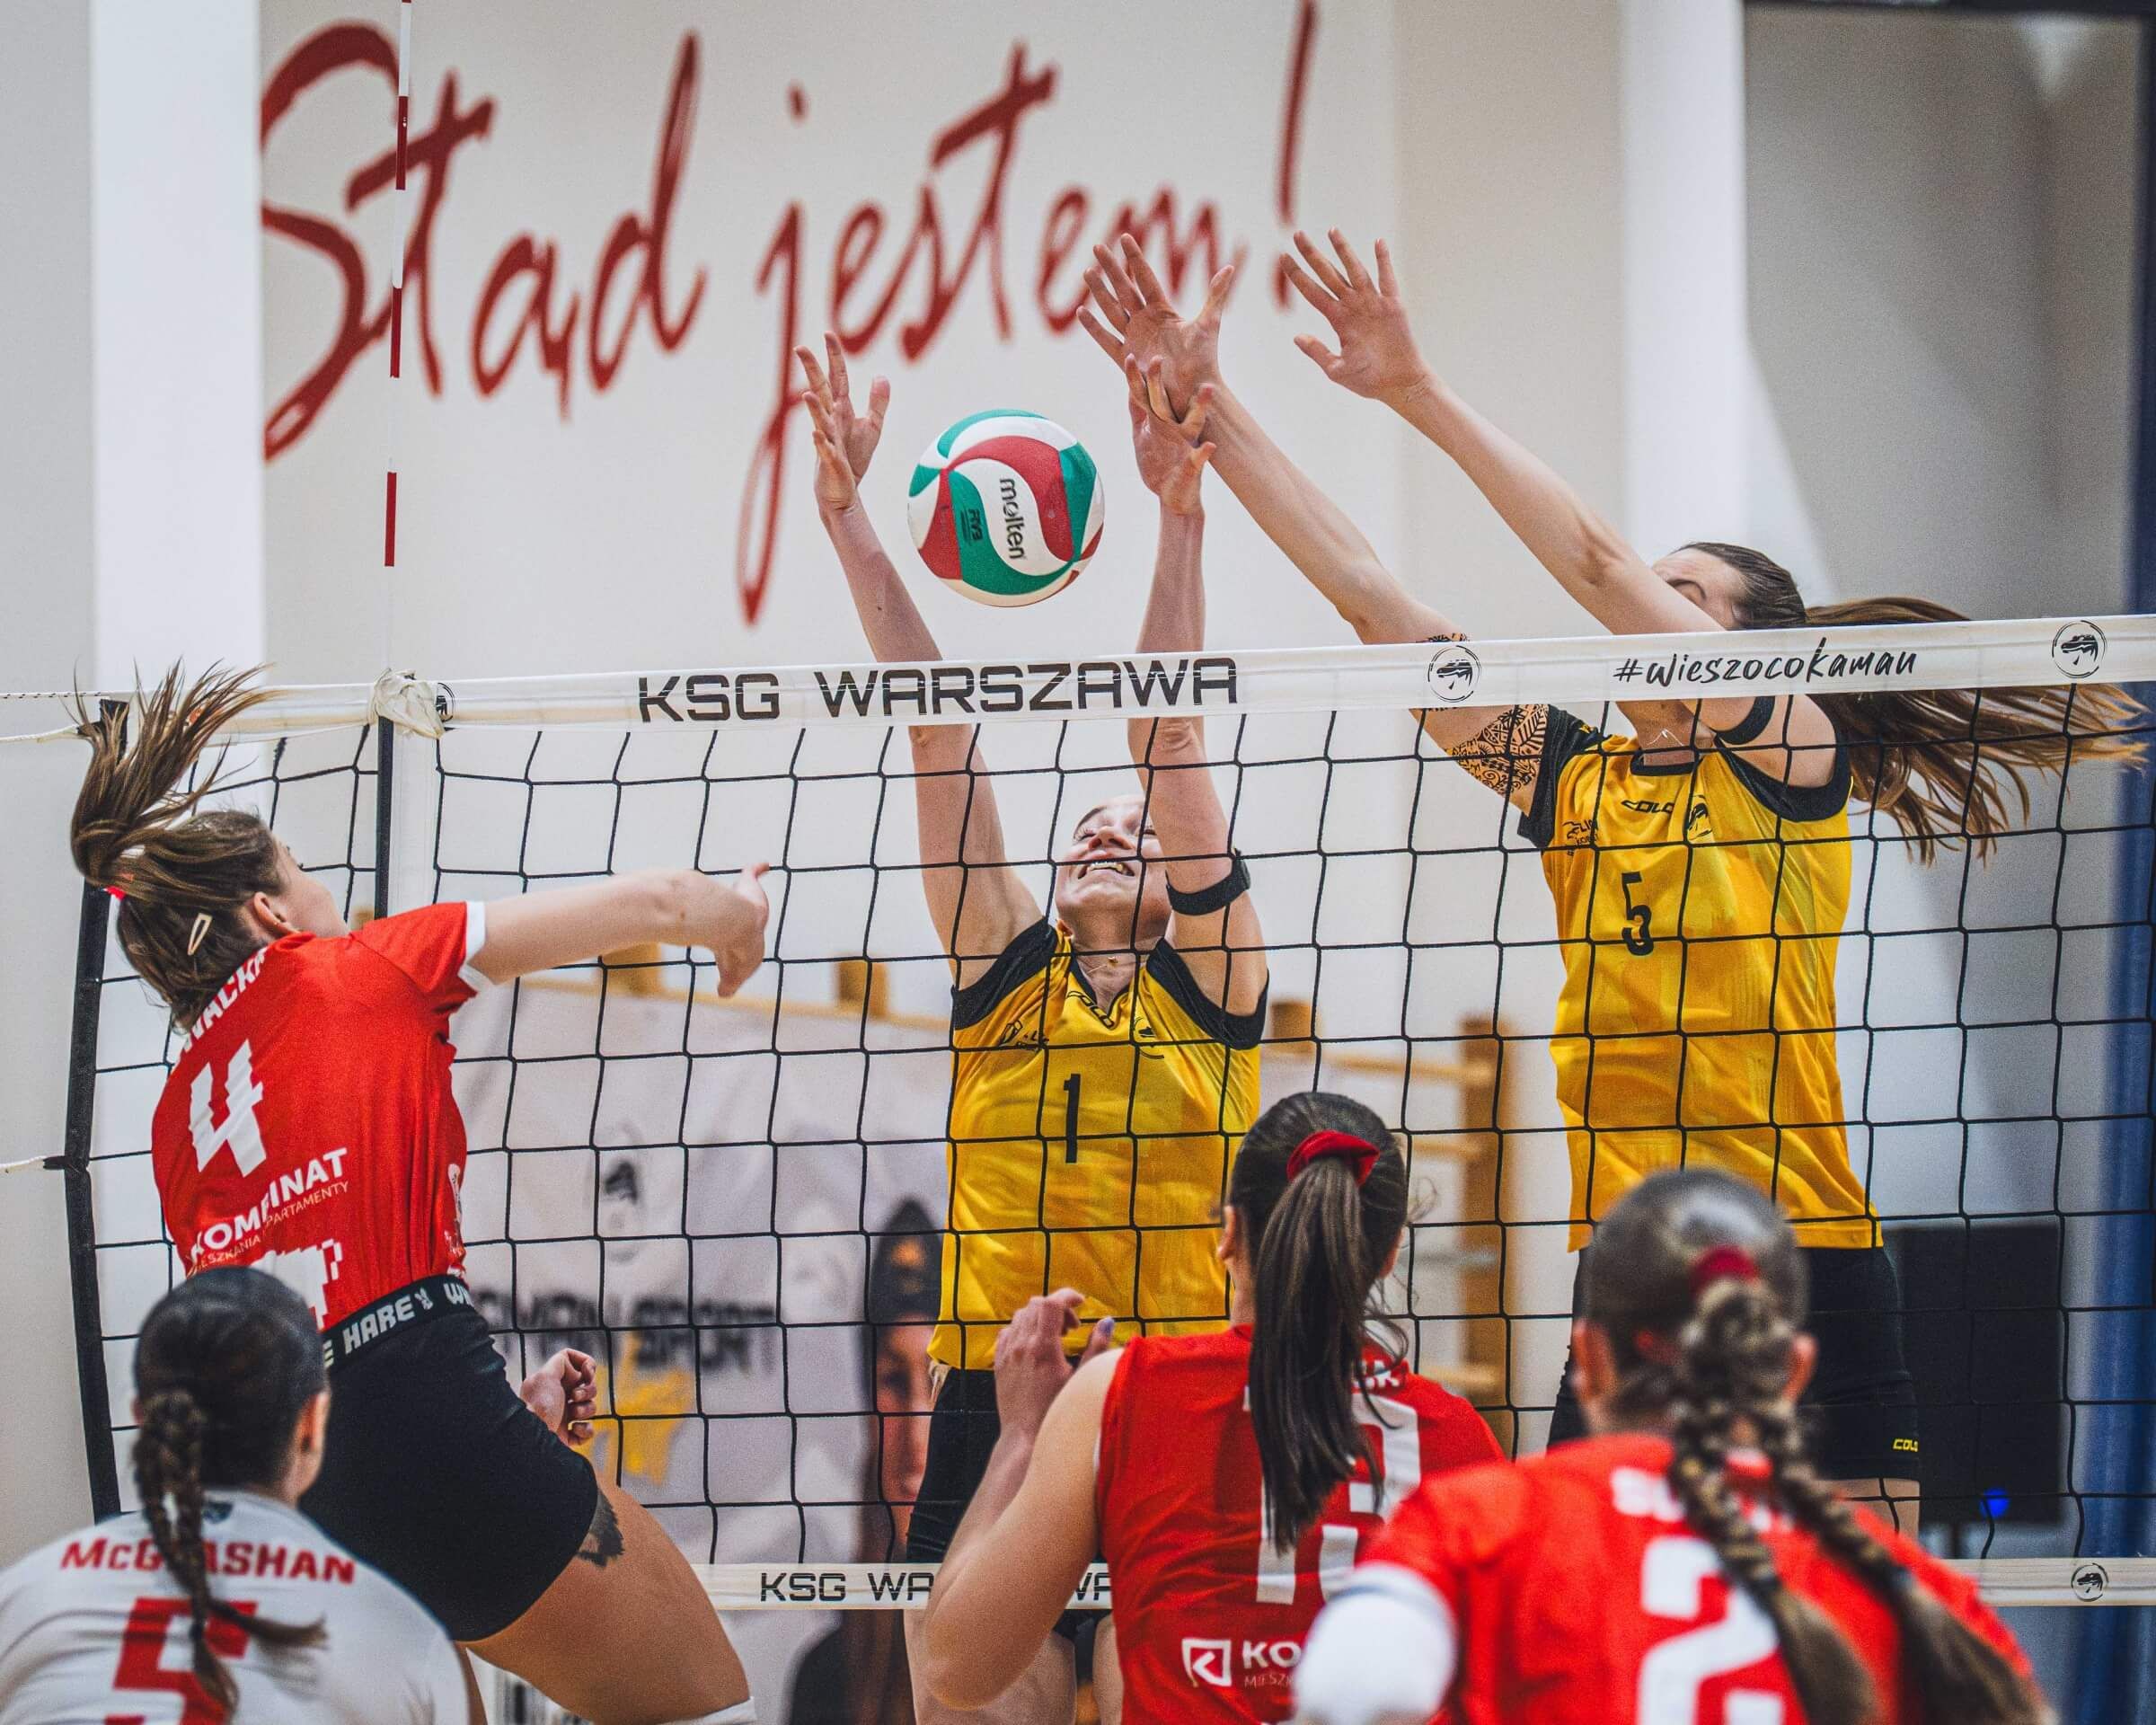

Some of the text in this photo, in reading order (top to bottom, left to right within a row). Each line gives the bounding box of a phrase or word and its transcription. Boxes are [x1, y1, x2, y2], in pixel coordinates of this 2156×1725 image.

[999, 478, 1025, 559] molten
[638, 657, 1239, 723] KSG WARSZAWA
[1621, 871, 1655, 956] 5
[189, 1039, 267, 1178] 4
[1064, 1074, 1082, 1163] 1
[266, 1180, 349, 1228] PARTAMENTY
[342, 1295, 416, 1355] HARE
[60, 1536, 356, 1585] McGSHAN
[761, 1572, 846, 1602] KSG
